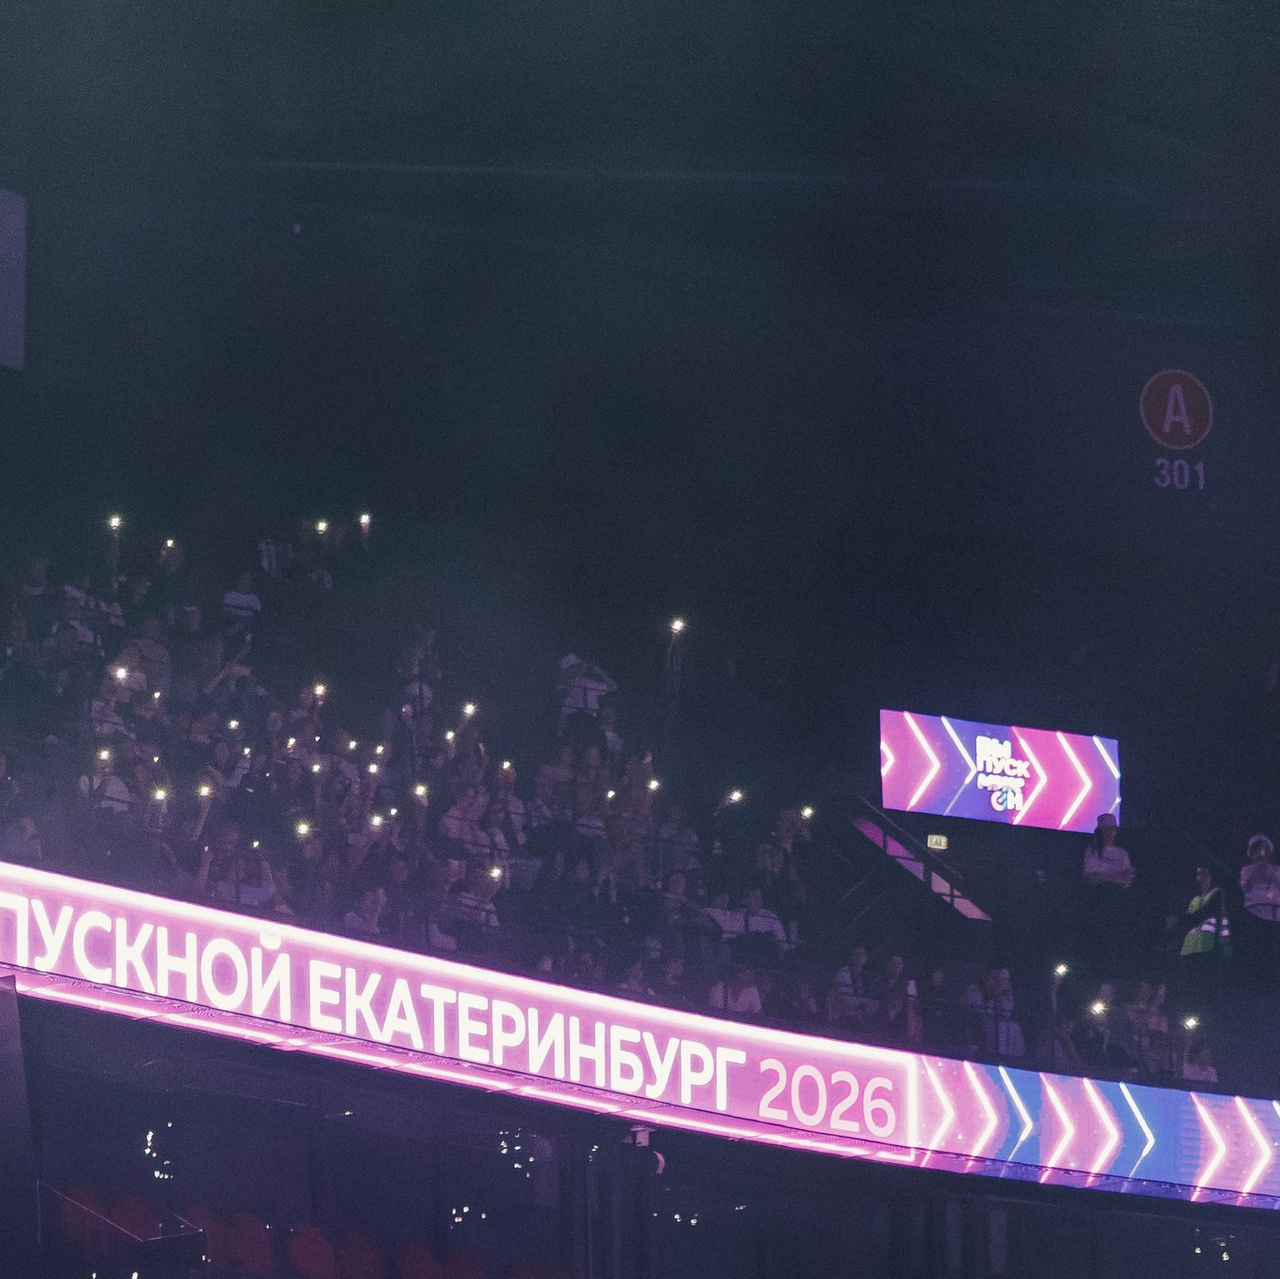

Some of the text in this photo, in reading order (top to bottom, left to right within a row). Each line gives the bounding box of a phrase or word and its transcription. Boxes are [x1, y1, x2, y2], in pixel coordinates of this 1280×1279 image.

[1154, 458, 1205, 490] 301
[308, 964, 746, 1111] ЕКАТЕРИНБУРГ
[758, 1058, 897, 1138] 2026
